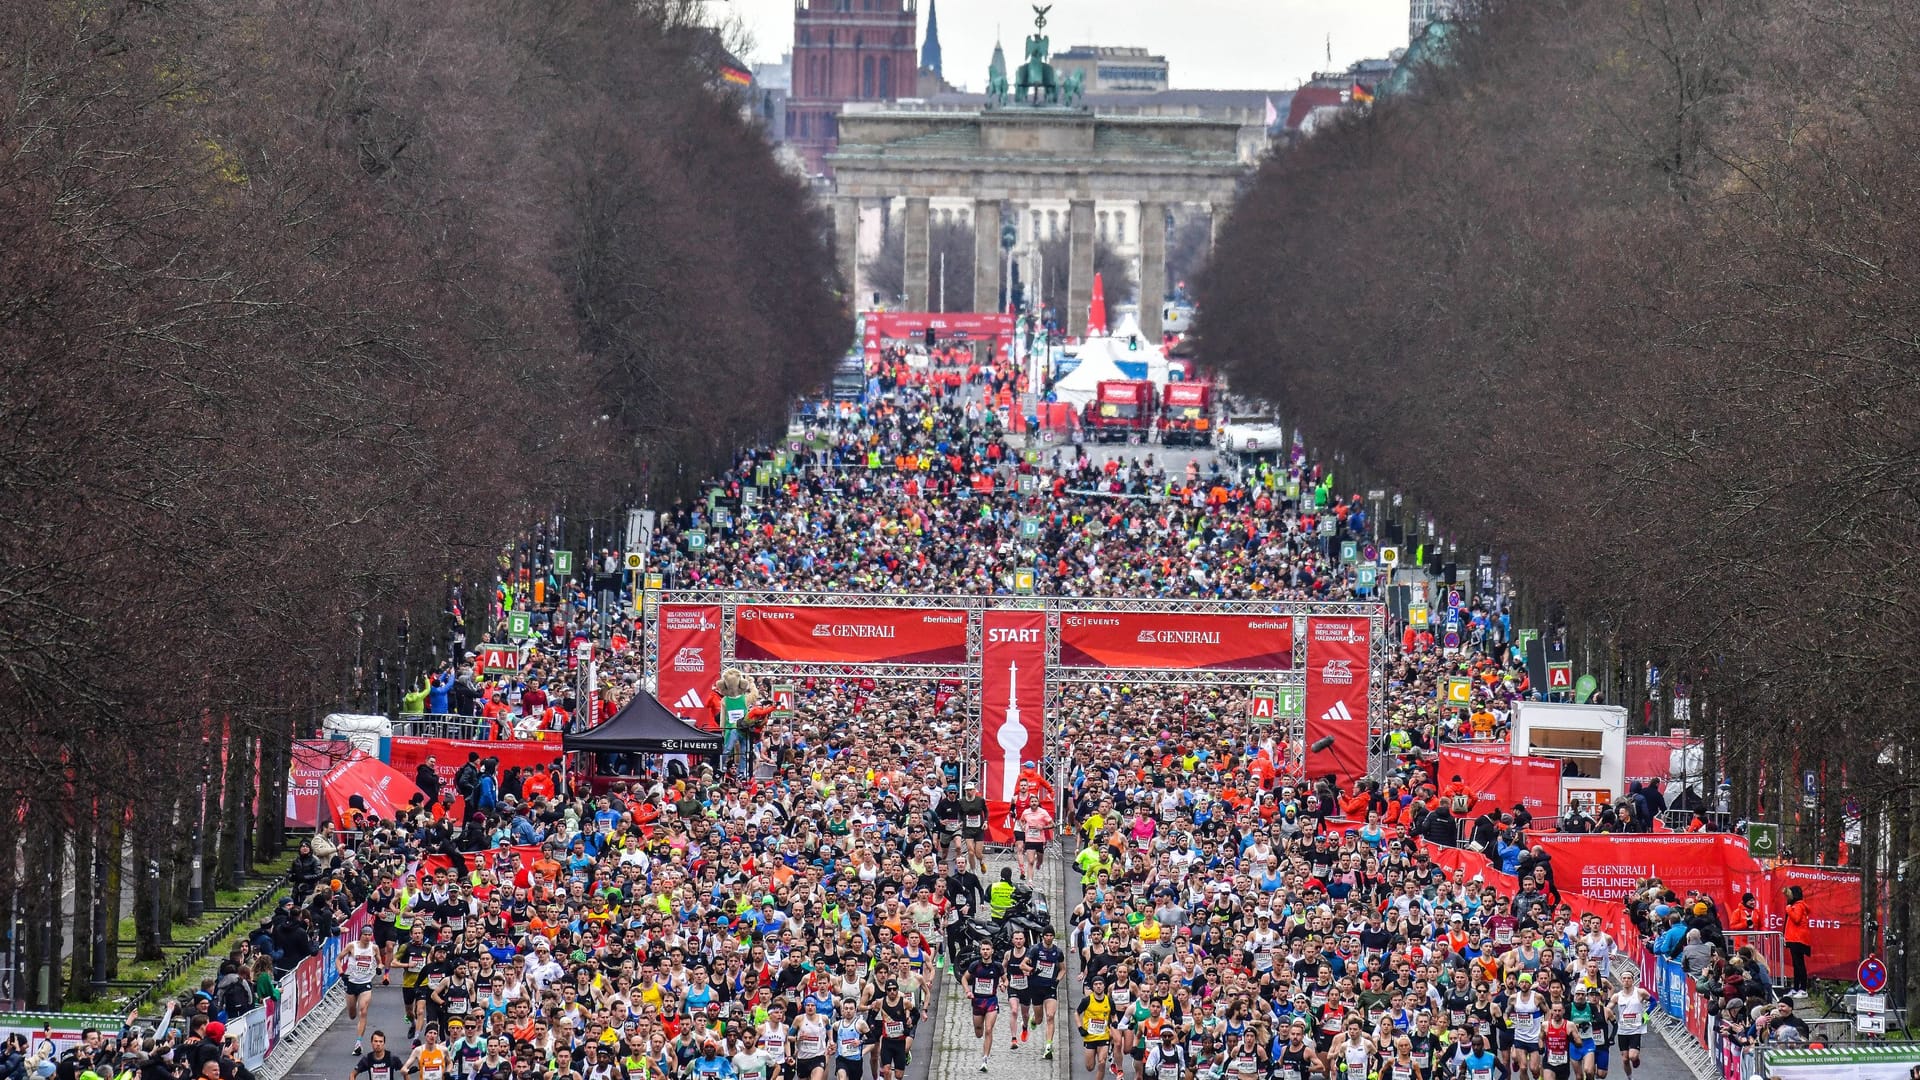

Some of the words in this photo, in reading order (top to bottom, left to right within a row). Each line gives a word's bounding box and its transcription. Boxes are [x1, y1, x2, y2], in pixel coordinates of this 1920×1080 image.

[692, 536, 702, 546] D
[1344, 547, 1354, 559] D
[1019, 575, 1028, 587] C
[1362, 570, 1372, 583] D
[762, 612, 795, 620] EVENTS
[923, 615, 963, 625] #berlinhalf
[1088, 618, 1120, 626] EVENTS
[513, 618, 524, 633] B
[832, 624, 895, 638] GENERALI
[1248, 621, 1288, 631] #berlinhalf
[988, 628, 1040, 643] START
[1157, 631, 1221, 644] GENERALI
[488, 652, 501, 667] A
[506, 653, 515, 668] A
[1553, 669, 1567, 686] A
[1453, 685, 1467, 700] C
[1256, 699, 1269, 716] A
[684, 742, 718, 750] EVENTS
[1597, 865, 1646, 875] GENERALI
[1581, 877, 1636, 887] BERLINER
